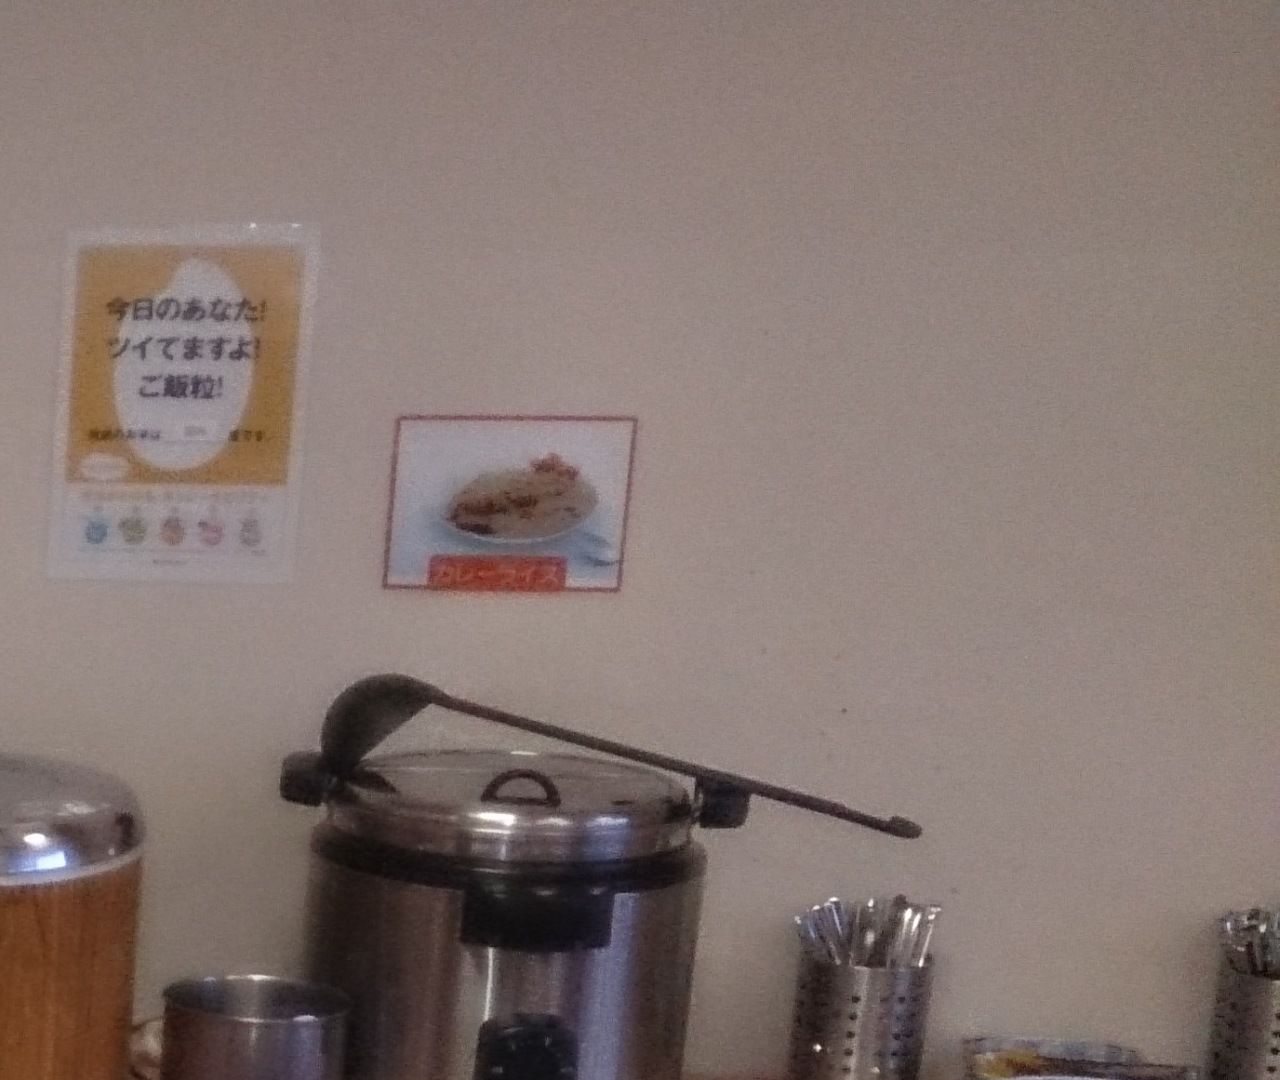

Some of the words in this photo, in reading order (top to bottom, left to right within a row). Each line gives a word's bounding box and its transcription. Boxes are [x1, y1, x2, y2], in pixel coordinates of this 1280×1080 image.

[106, 297, 267, 322] 今日のあなた!
[434, 563, 560, 587] カレーライス
